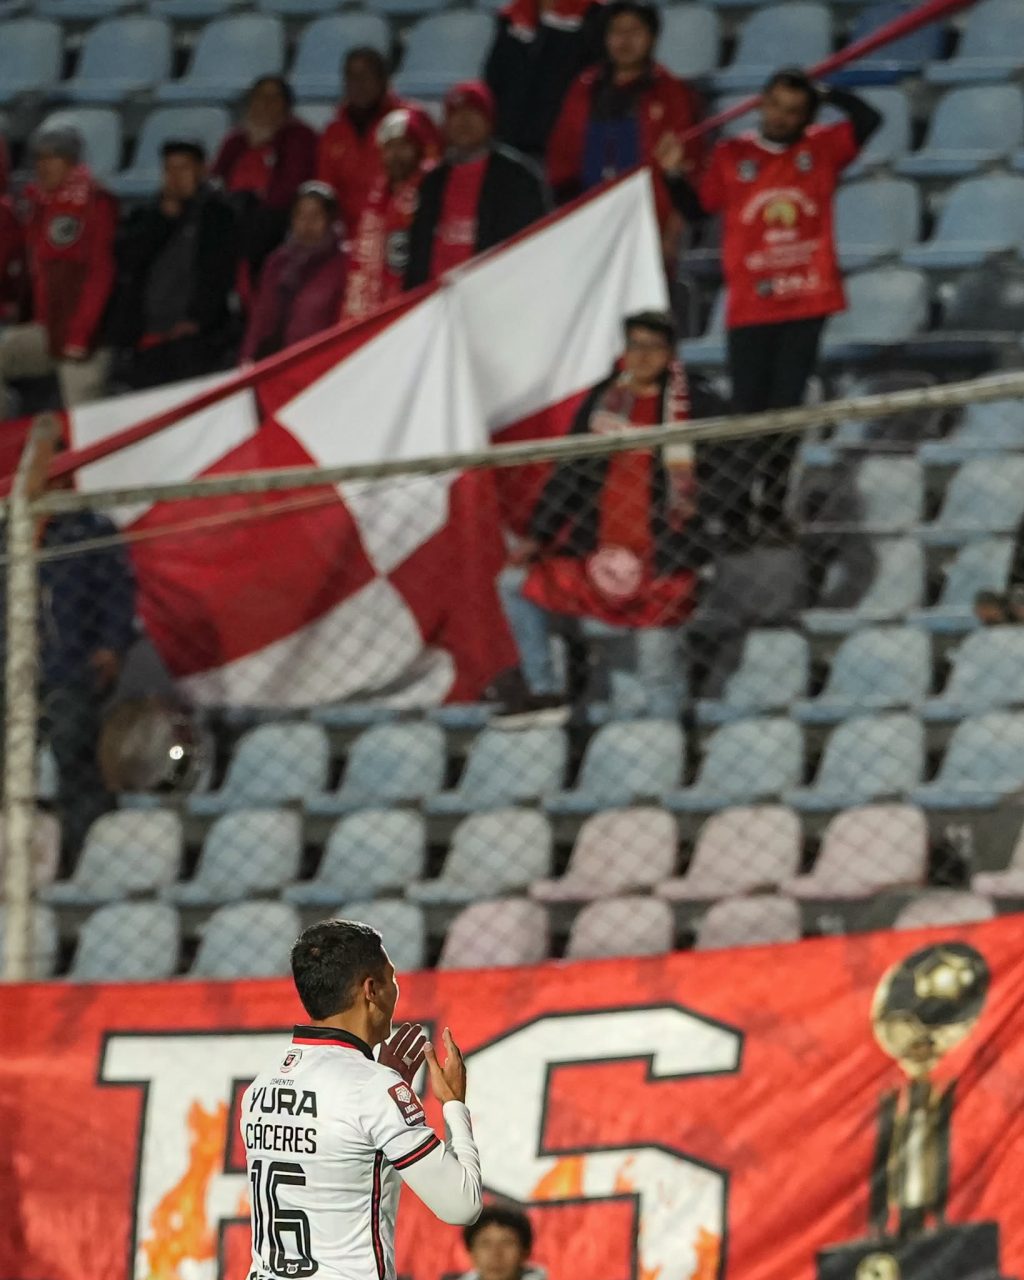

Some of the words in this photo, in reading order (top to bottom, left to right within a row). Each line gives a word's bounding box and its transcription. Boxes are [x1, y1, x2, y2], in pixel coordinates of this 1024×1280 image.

[249, 1087, 318, 1118] YURA
[245, 1116, 317, 1154] CÁCERES
[250, 1159, 319, 1279] 16
